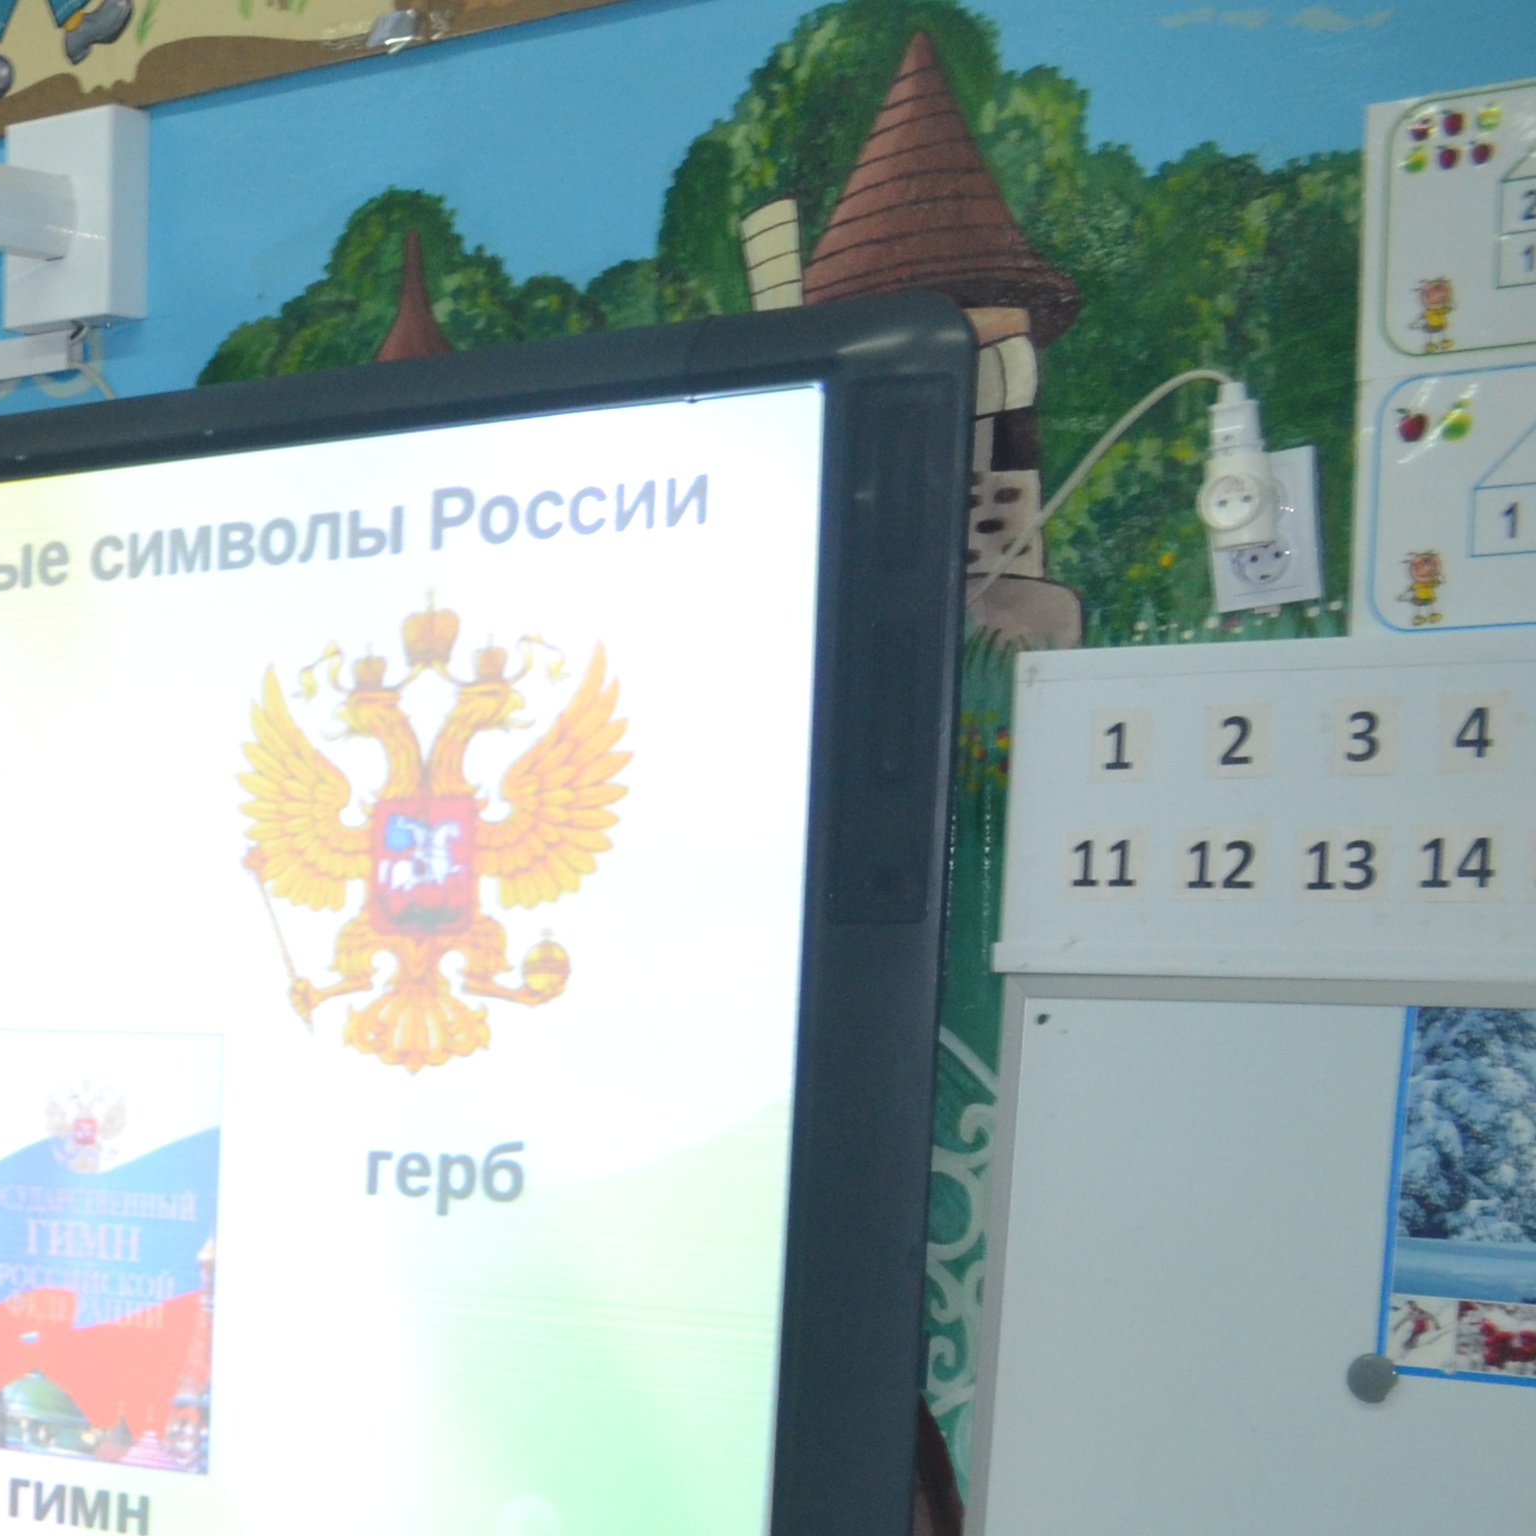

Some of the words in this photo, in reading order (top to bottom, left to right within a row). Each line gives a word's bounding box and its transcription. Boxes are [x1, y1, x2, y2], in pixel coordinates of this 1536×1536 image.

[90, 491, 405, 585] символы
[430, 468, 711, 560] России
[1500, 502, 1521, 540] 1
[1103, 722, 1133, 770] 1
[1219, 715, 1252, 765] 2
[1345, 711, 1380, 762] 3
[1455, 706, 1493, 758] 4
[1071, 839, 1136, 888] 11
[1186, 840, 1256, 889] 12
[1305, 840, 1377, 890] 13
[1420, 836, 1496, 888] 14
[365, 1140, 527, 1215] герб
[26, 1219, 142, 1262] ГИМН
